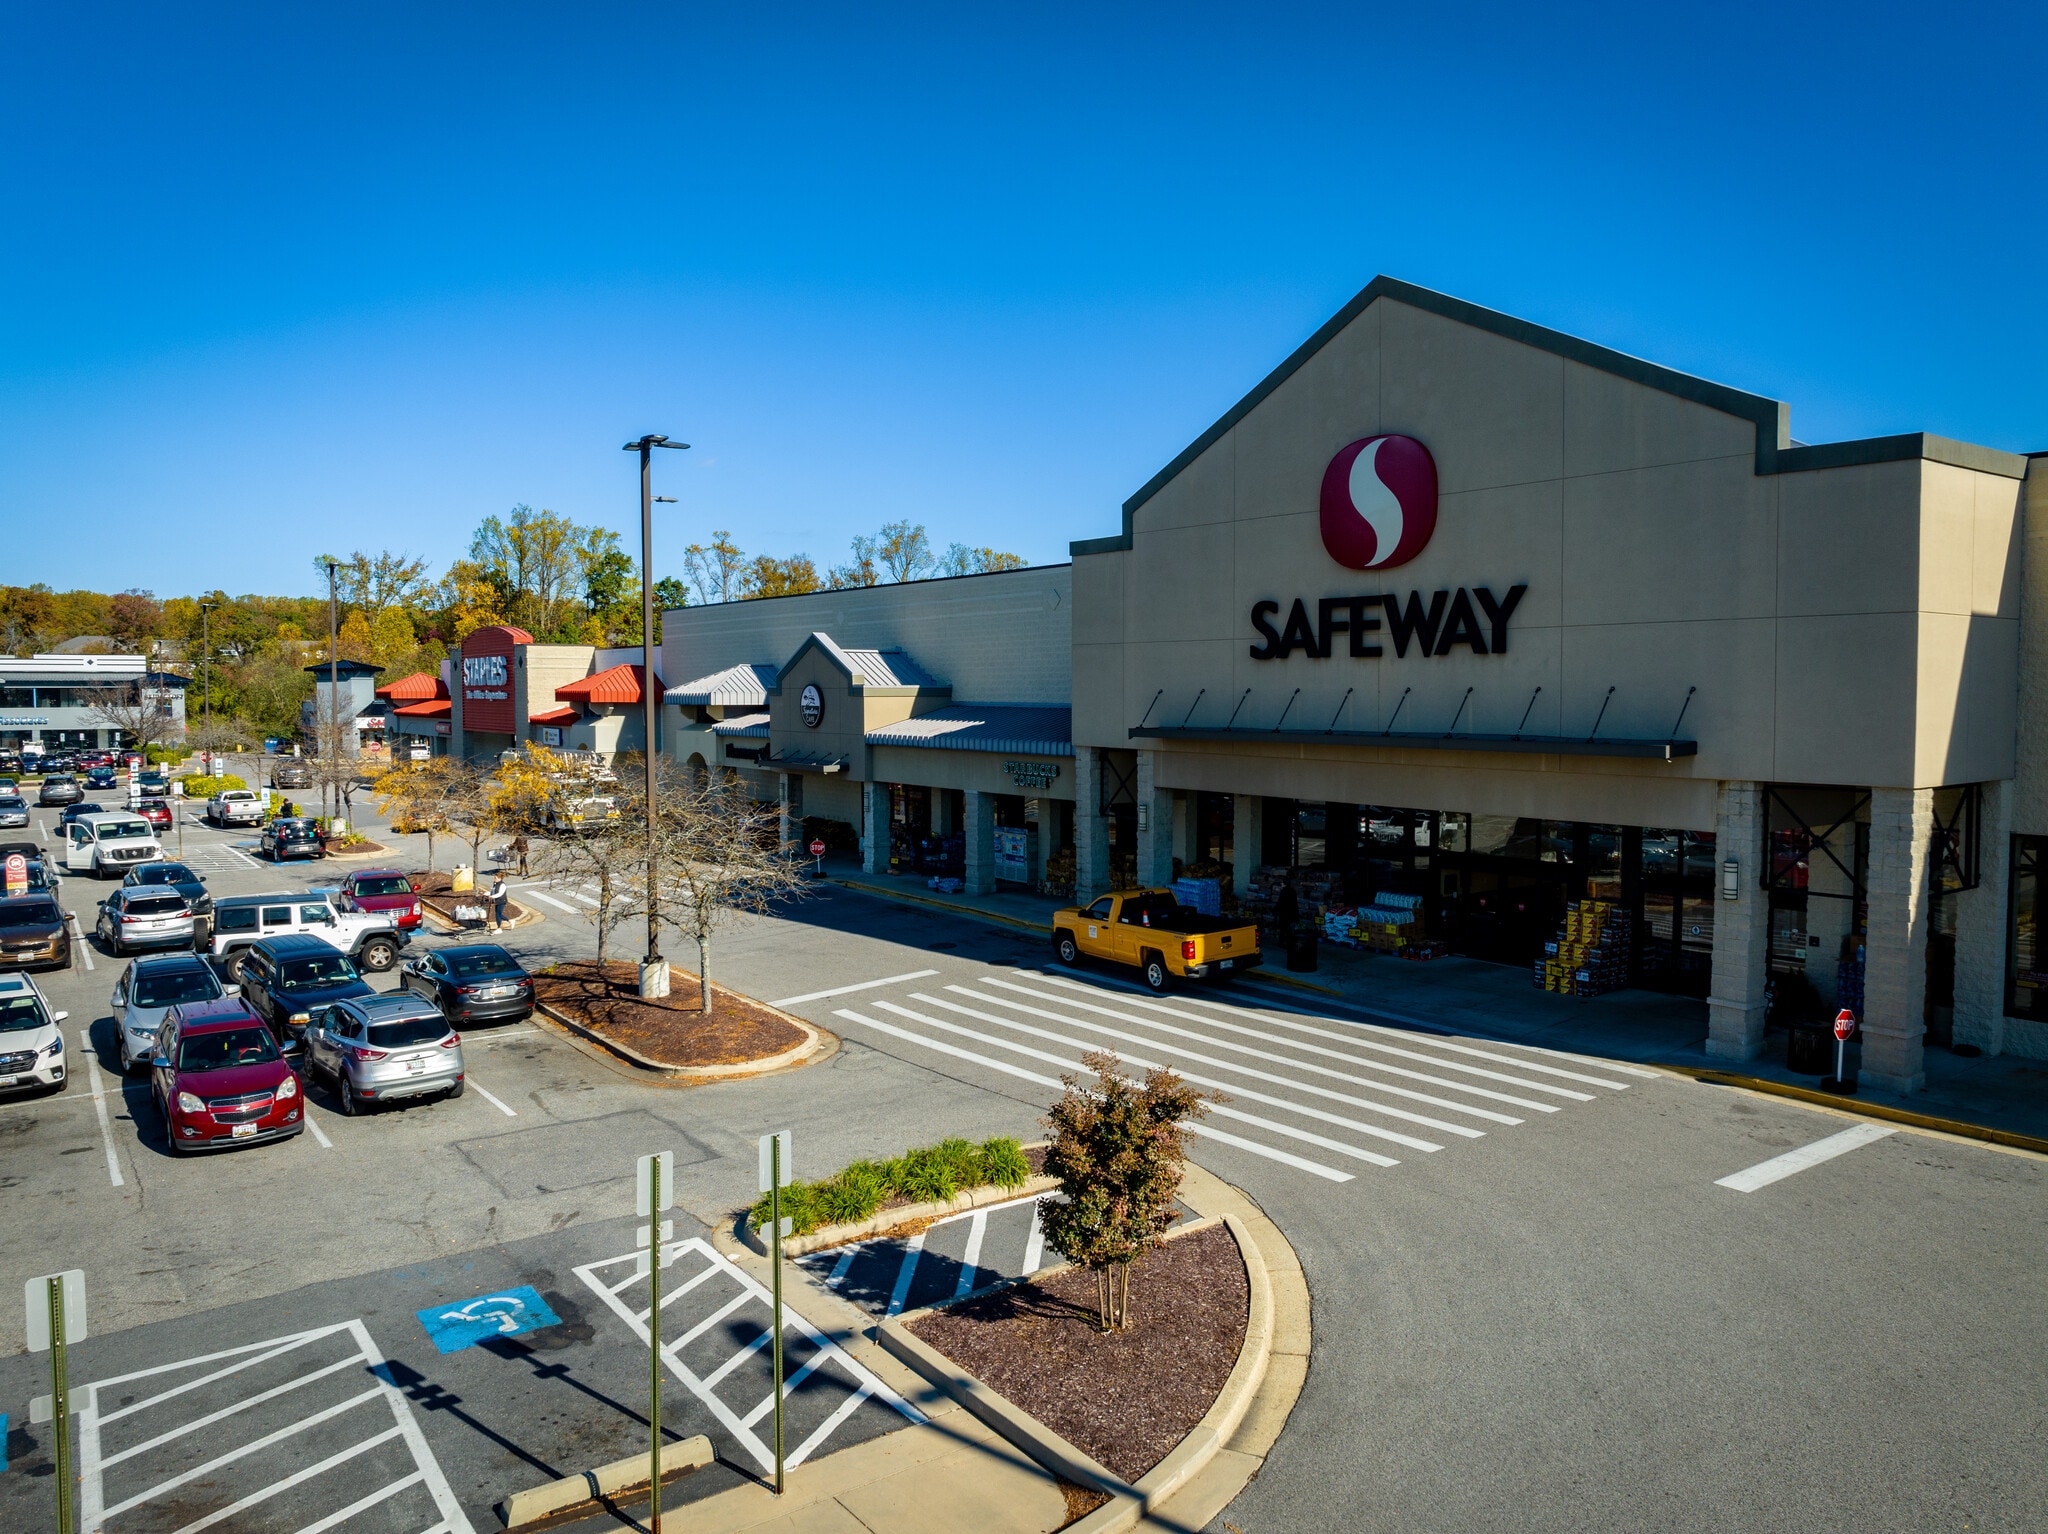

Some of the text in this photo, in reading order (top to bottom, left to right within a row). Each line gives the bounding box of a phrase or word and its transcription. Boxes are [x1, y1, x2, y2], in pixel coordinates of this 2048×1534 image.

[1250, 584, 1528, 660] SAFEWAY
[464, 656, 507, 686] STAPLES
[1003, 762, 1057, 777] STARBUCKS
[1013, 774, 1047, 789] COFFEE
[1836, 1019, 1854, 1031] STOP
